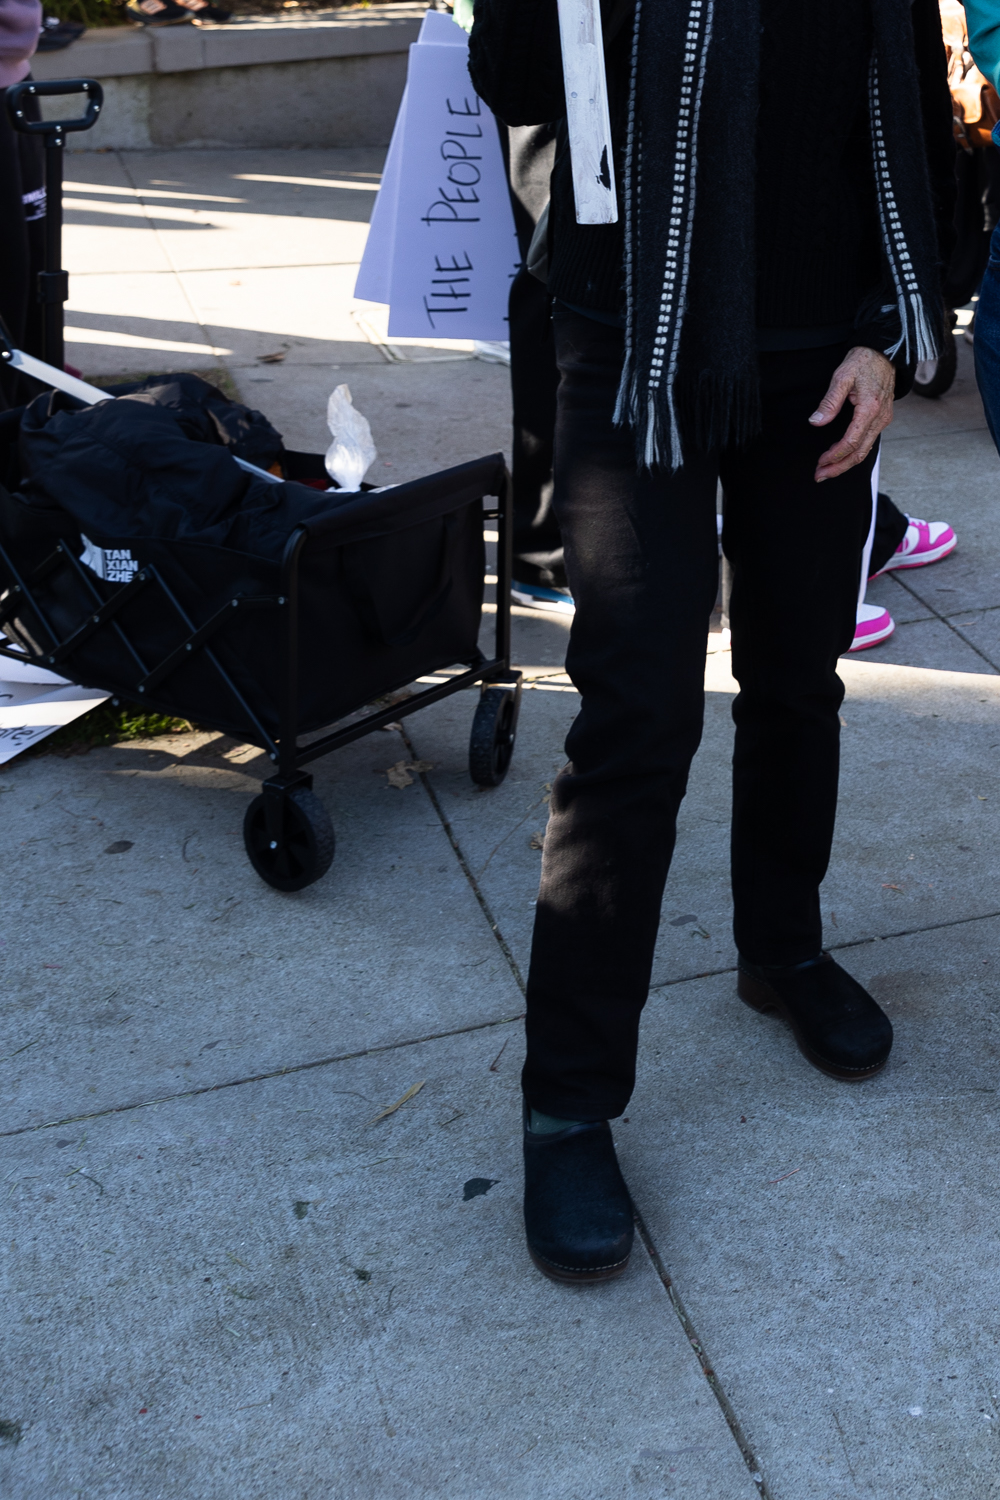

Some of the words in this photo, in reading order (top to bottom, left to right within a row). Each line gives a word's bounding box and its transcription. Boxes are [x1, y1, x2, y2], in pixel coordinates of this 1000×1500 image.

[421, 95, 483, 226] PEOPLE
[423, 251, 473, 329] THE
[104, 549, 131, 560] TAN
[106, 560, 138, 571] XIAN
[106, 571, 133, 583] ZHE
